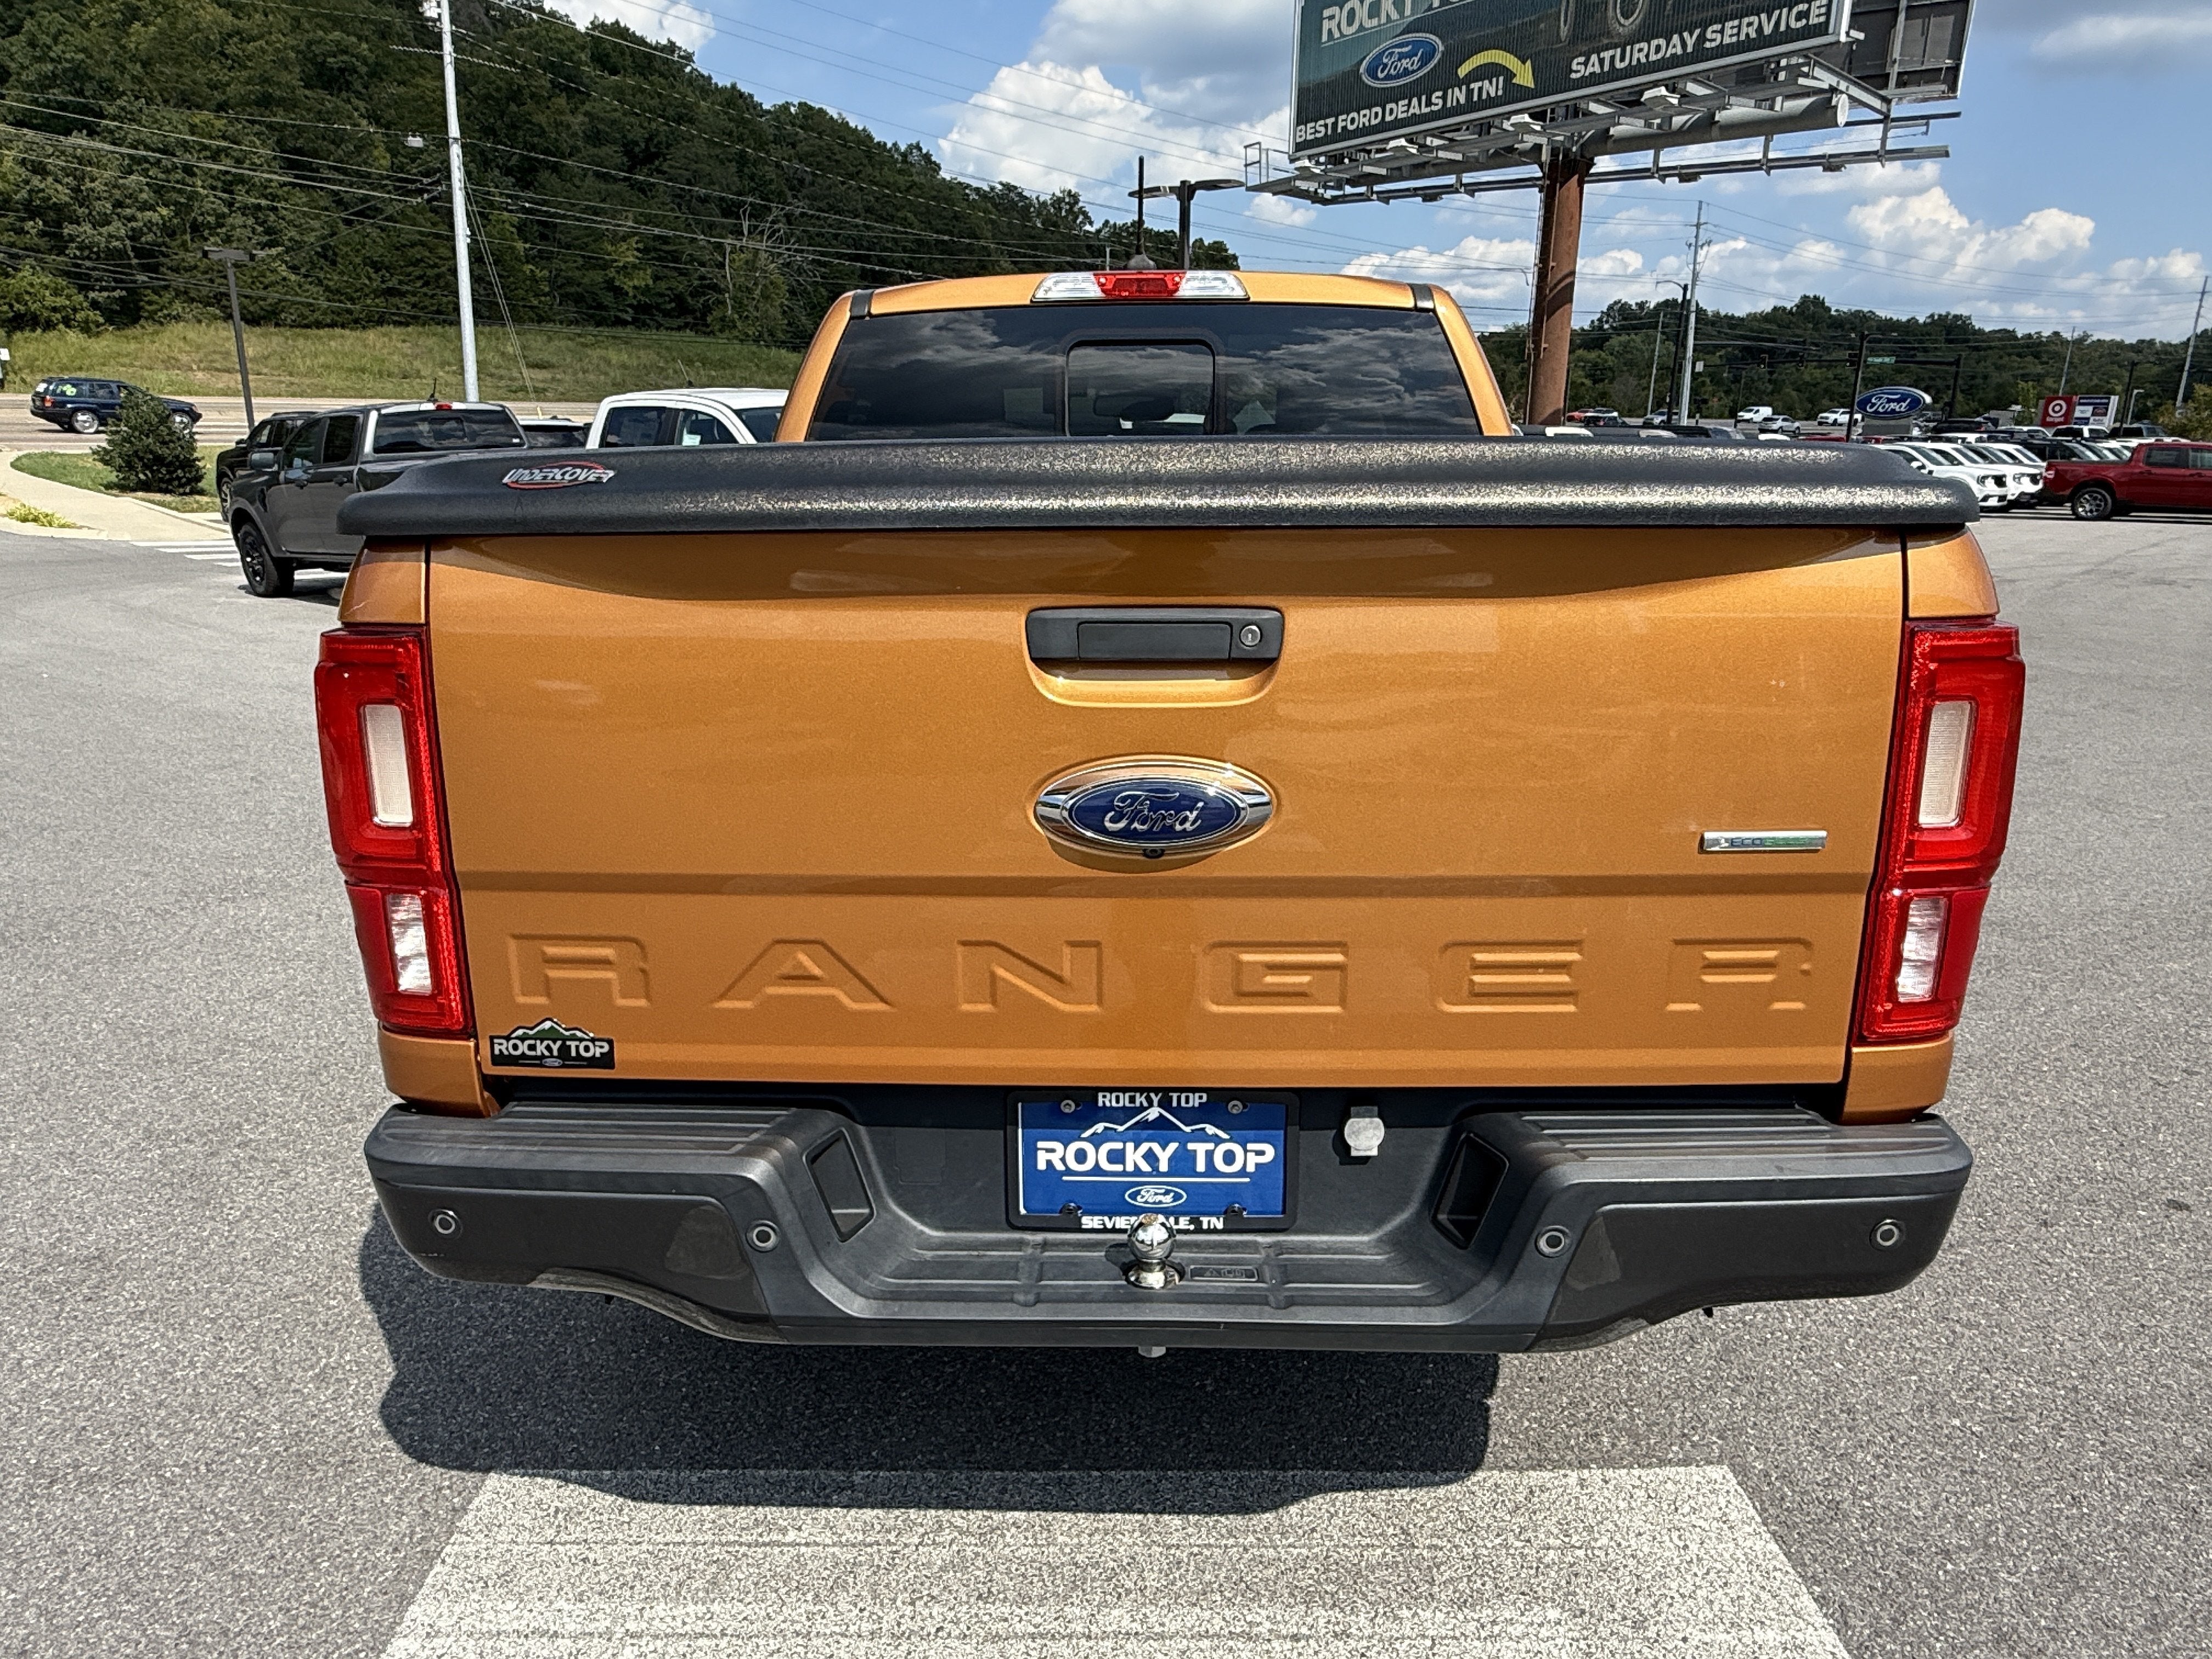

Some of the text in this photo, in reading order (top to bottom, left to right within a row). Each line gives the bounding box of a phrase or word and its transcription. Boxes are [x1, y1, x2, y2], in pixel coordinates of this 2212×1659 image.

[1570, 1, 1827, 79] SATURDAY SERVICE
[1378, 46, 1424, 77] Ford
[1296, 76, 1504, 143] BEST FORD DEALS IN TN!
[1866, 394, 1911, 412] Ford
[1104, 791, 1204, 832] Ford
[506, 934, 1814, 1014] RANGER
[493, 1039, 610, 1058] ROCKY TOP
[1098, 1092, 1207, 1107] ROCKY TOP
[1036, 1141, 1275, 1173] ROCKY TOP
[1137, 1188, 1175, 1204] Ford
[1200, 1216, 1224, 1230] TN
